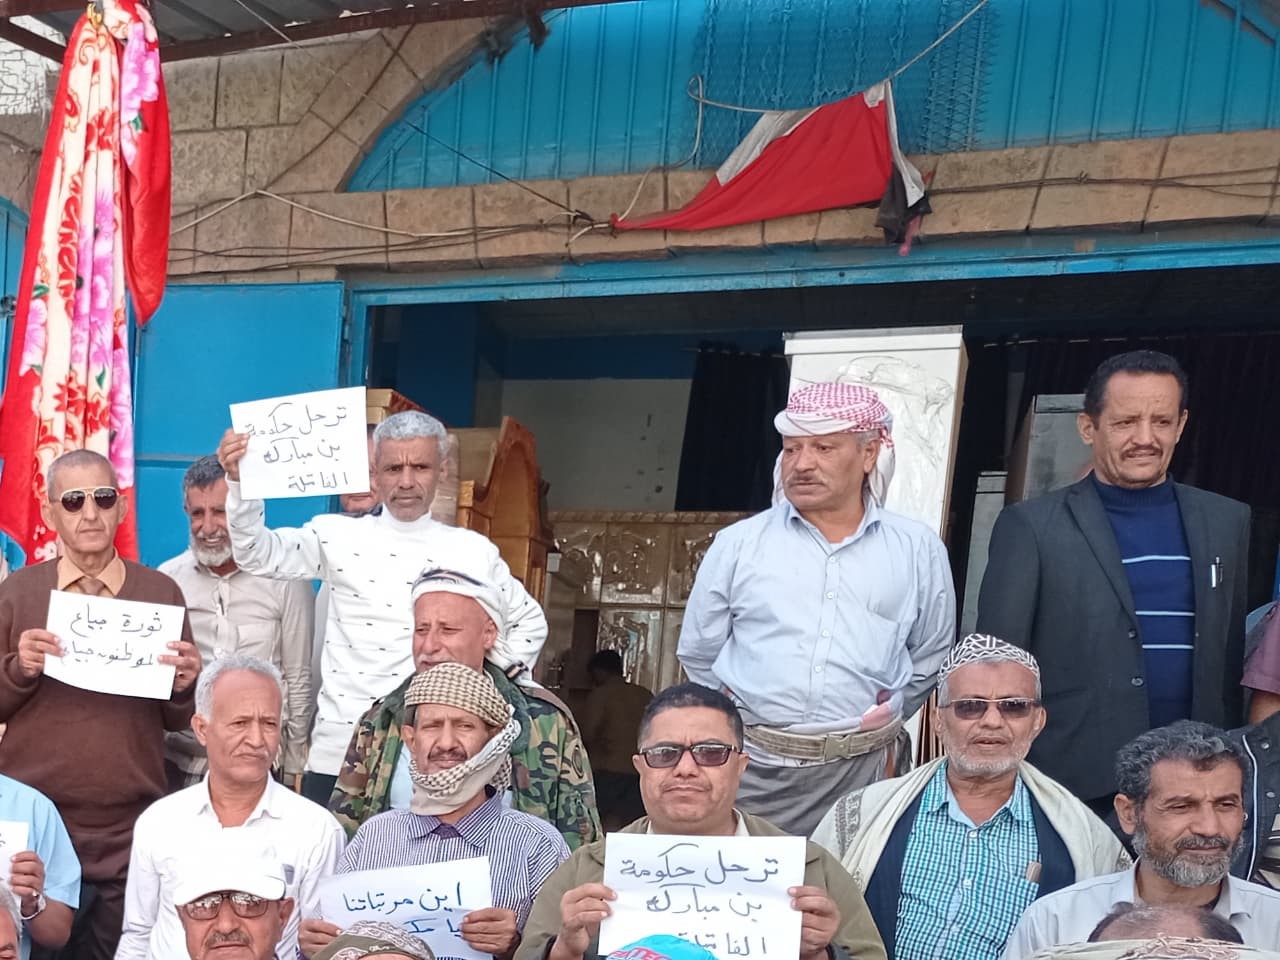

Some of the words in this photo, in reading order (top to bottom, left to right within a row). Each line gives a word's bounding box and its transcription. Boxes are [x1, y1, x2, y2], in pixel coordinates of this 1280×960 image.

[298, 404, 347, 435] ترحل
[620, 843, 699, 883] حكومة
[704, 849, 779, 884] ترحل
[419, 881, 462, 913] اين
[646, 883, 720, 920] مبارك
[729, 892, 762, 922] بن
